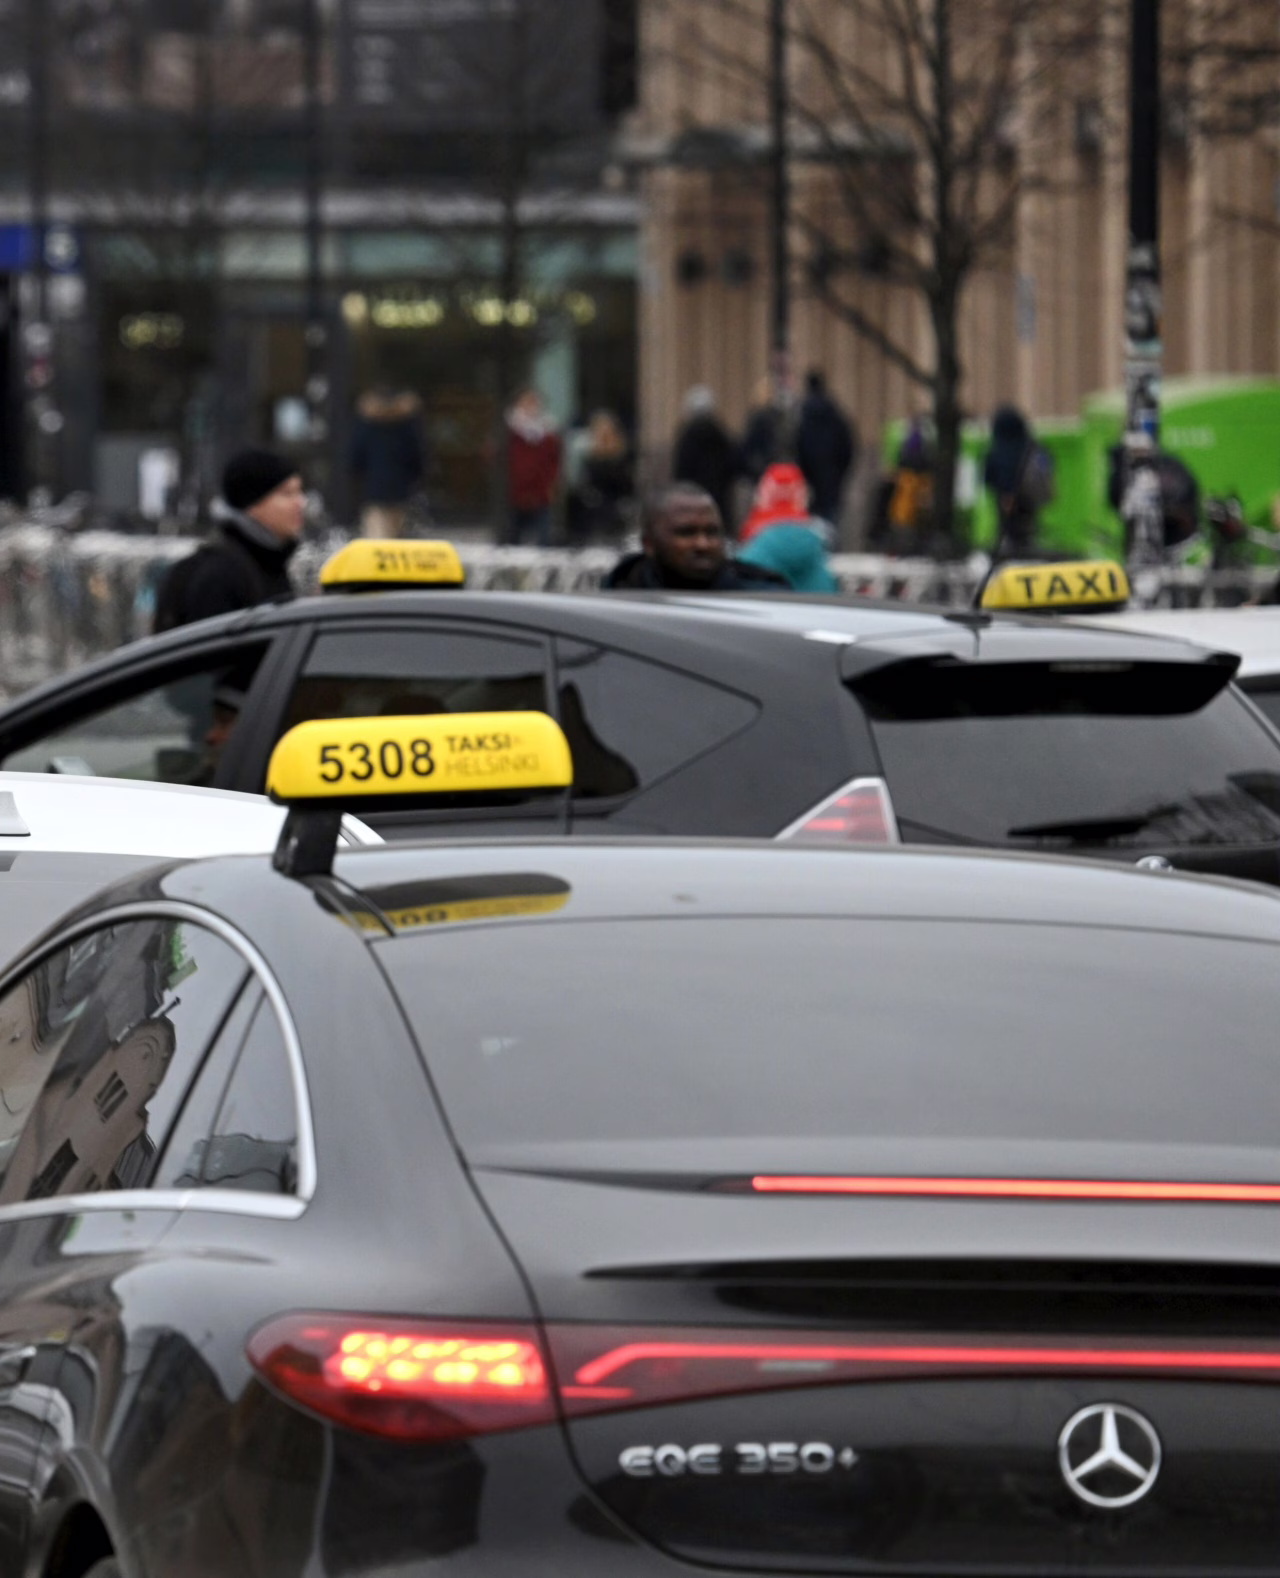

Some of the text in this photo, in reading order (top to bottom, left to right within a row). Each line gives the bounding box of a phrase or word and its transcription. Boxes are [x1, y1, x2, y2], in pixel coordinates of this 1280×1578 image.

[1016, 570, 1118, 600] TAXI
[319, 739, 435, 783] 5308
[445, 754, 539, 776] HELSINKI
[619, 1442, 857, 1476] EQE 350+
